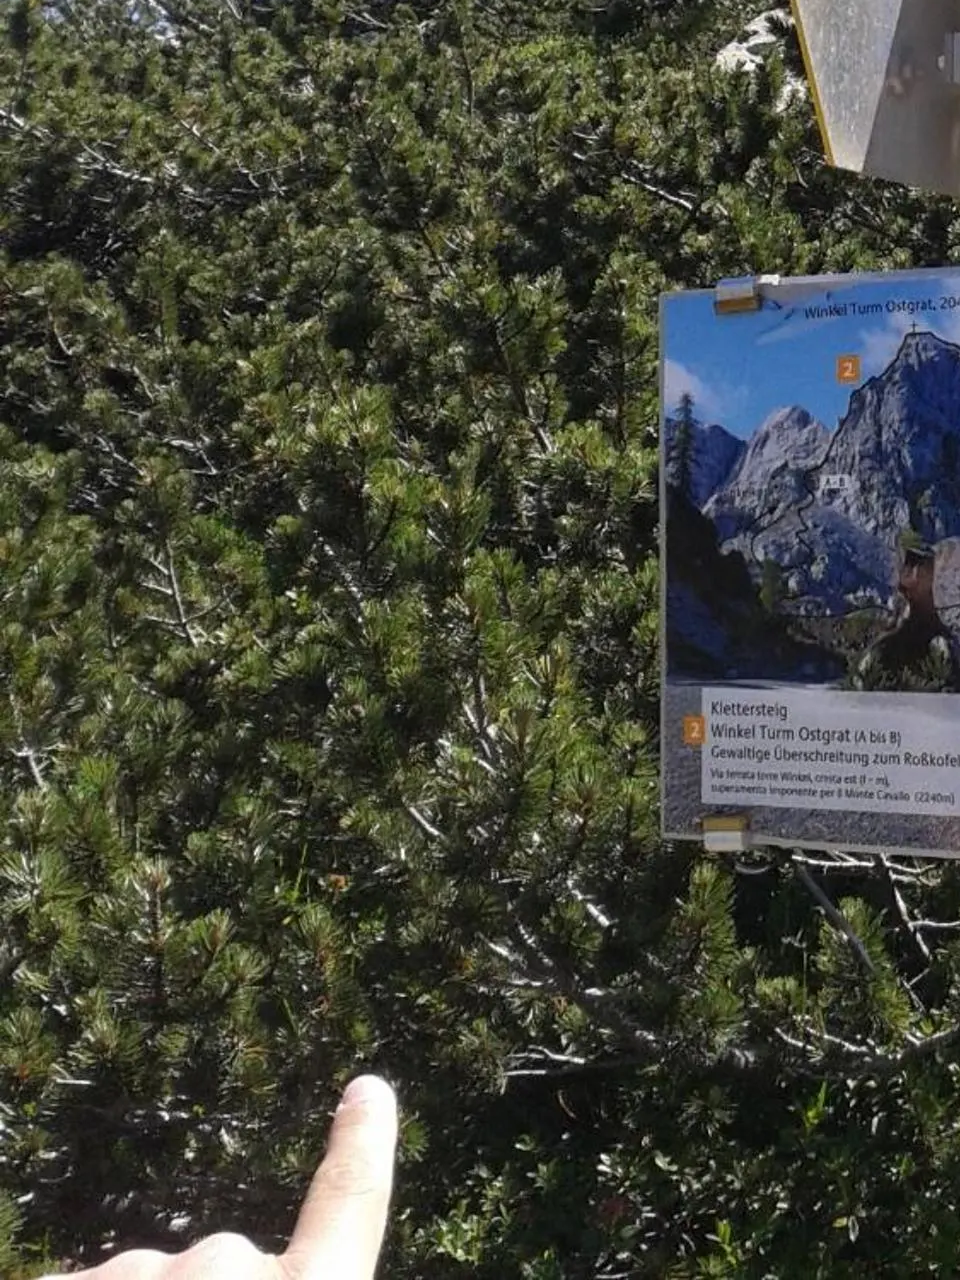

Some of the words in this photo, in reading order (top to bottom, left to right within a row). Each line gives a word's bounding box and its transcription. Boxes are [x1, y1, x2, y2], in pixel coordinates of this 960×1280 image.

[804, 304, 847, 321] Winkel
[849, 301, 881, 316] Turm
[842, 361, 857, 378] 2
[711, 701, 788, 720] Klettersteig
[711, 724, 755, 740] Winkel
[760, 724, 795, 741] Turm
[799, 726, 851, 745] Ostgrat
[869, 730, 887, 745] bis
[711, 745, 771, 763] Gewaltige
[774, 745, 869, 767] Überschreitung
[873, 753, 900, 765] zum
